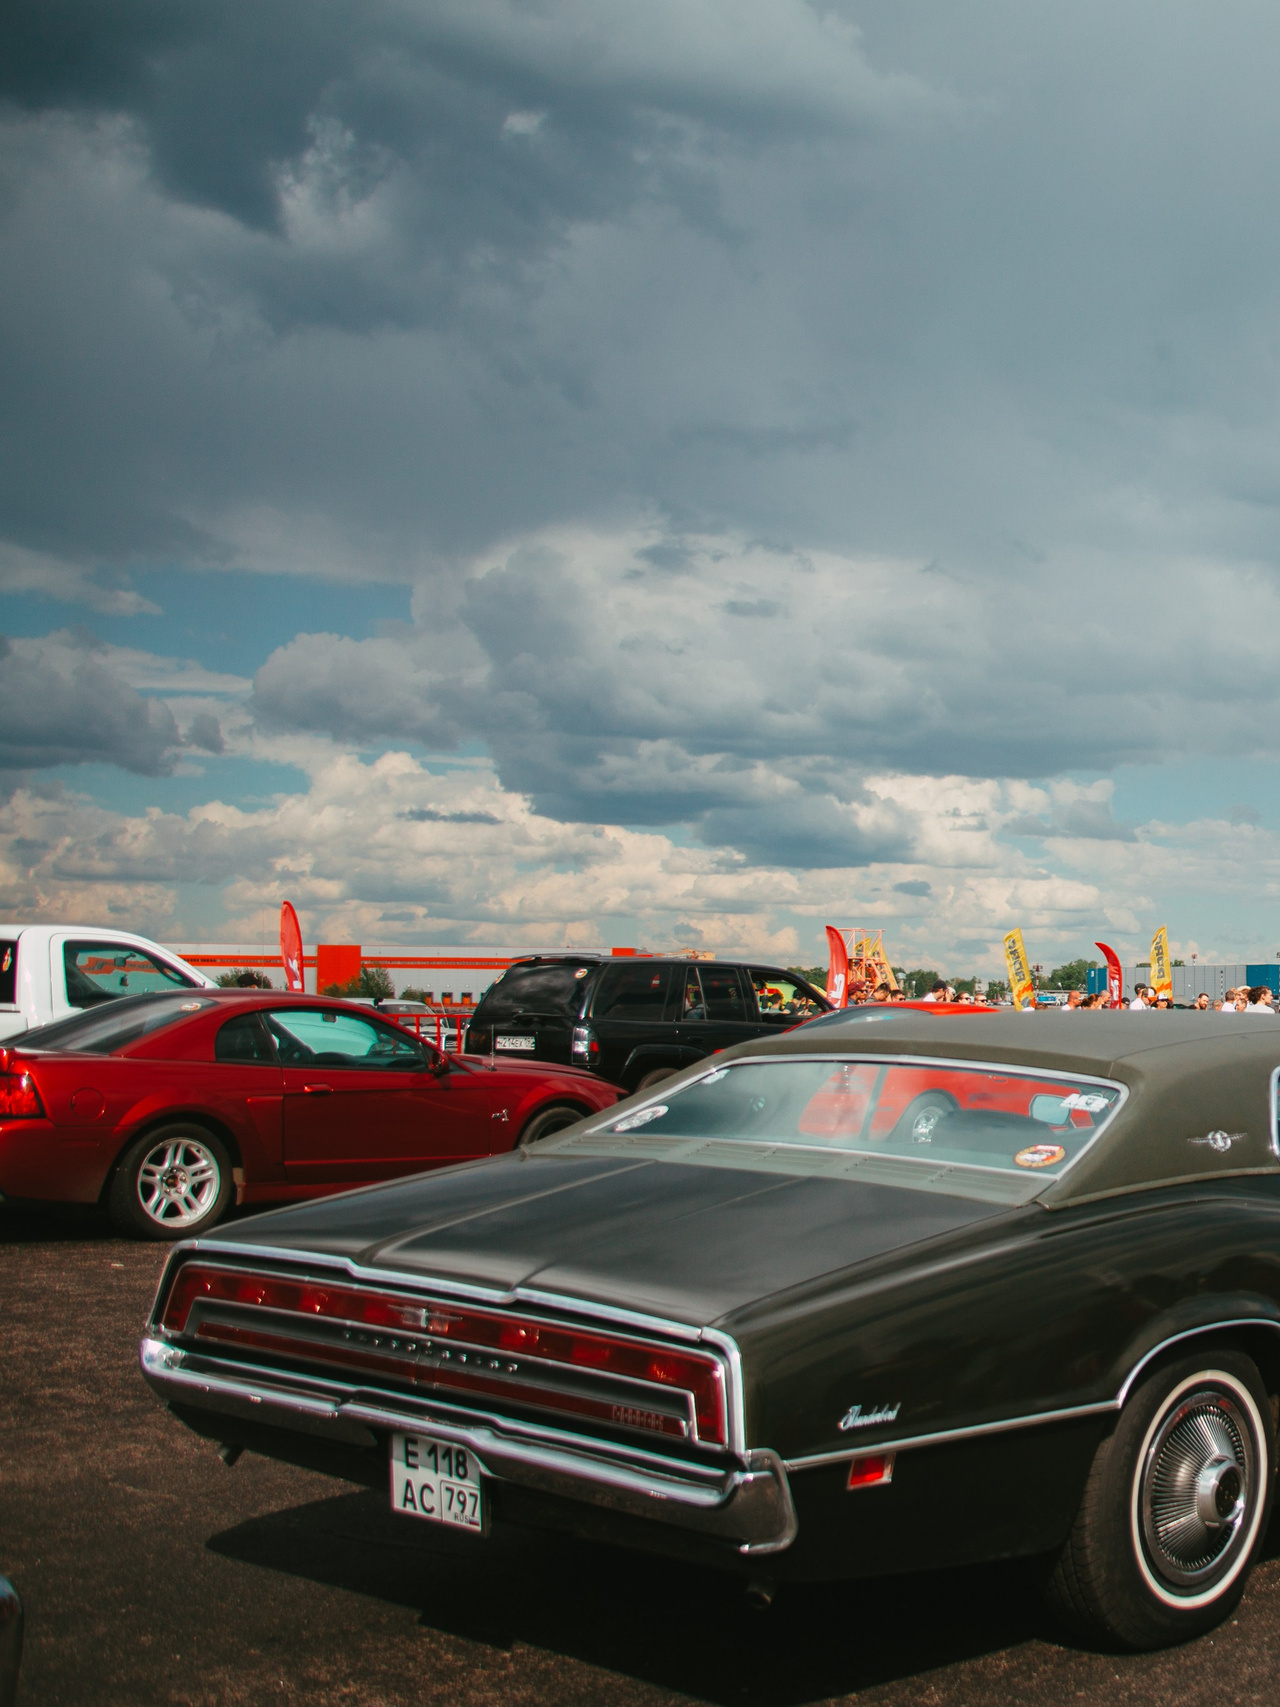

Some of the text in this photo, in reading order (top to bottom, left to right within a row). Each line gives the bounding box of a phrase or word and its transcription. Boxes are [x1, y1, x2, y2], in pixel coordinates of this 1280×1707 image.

[838, 1401, 902, 1430] Thunderbird
[404, 1437, 469, 1480] E 118
[403, 1478, 479, 1518] AC 797
[454, 1512, 469, 1524] RUS
